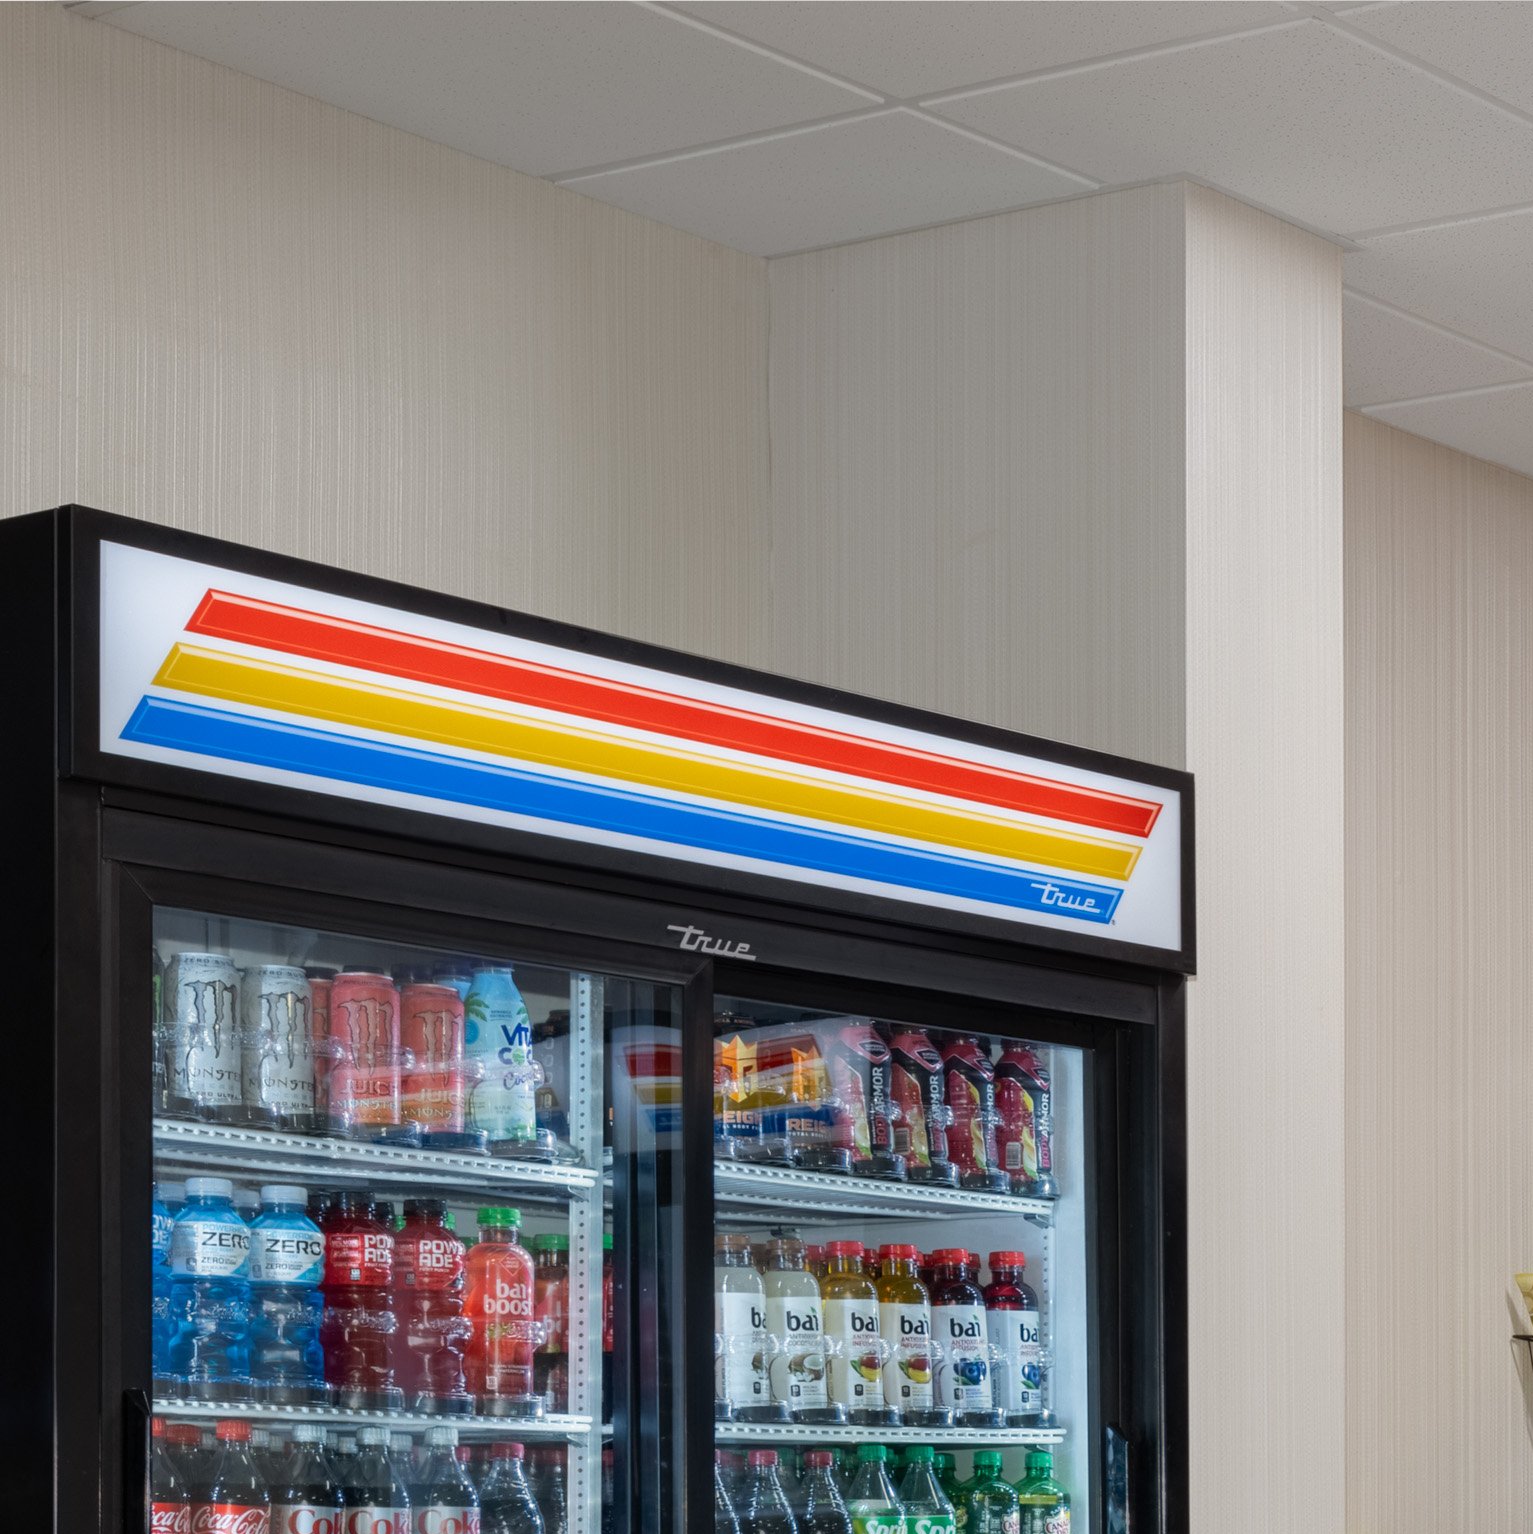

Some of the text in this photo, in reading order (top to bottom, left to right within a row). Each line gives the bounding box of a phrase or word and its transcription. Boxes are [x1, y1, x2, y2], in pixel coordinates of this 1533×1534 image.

[1030, 883, 1101, 914] true
[667, 925, 757, 961] true
[202, 1232, 250, 1249] ZERO
[266, 1238, 321, 1256] ZERO
[484, 1297, 533, 1315] boost
[787, 1305, 819, 1332] bai
[900, 1312, 929, 1335] bai
[950, 1314, 981, 1338] bai
